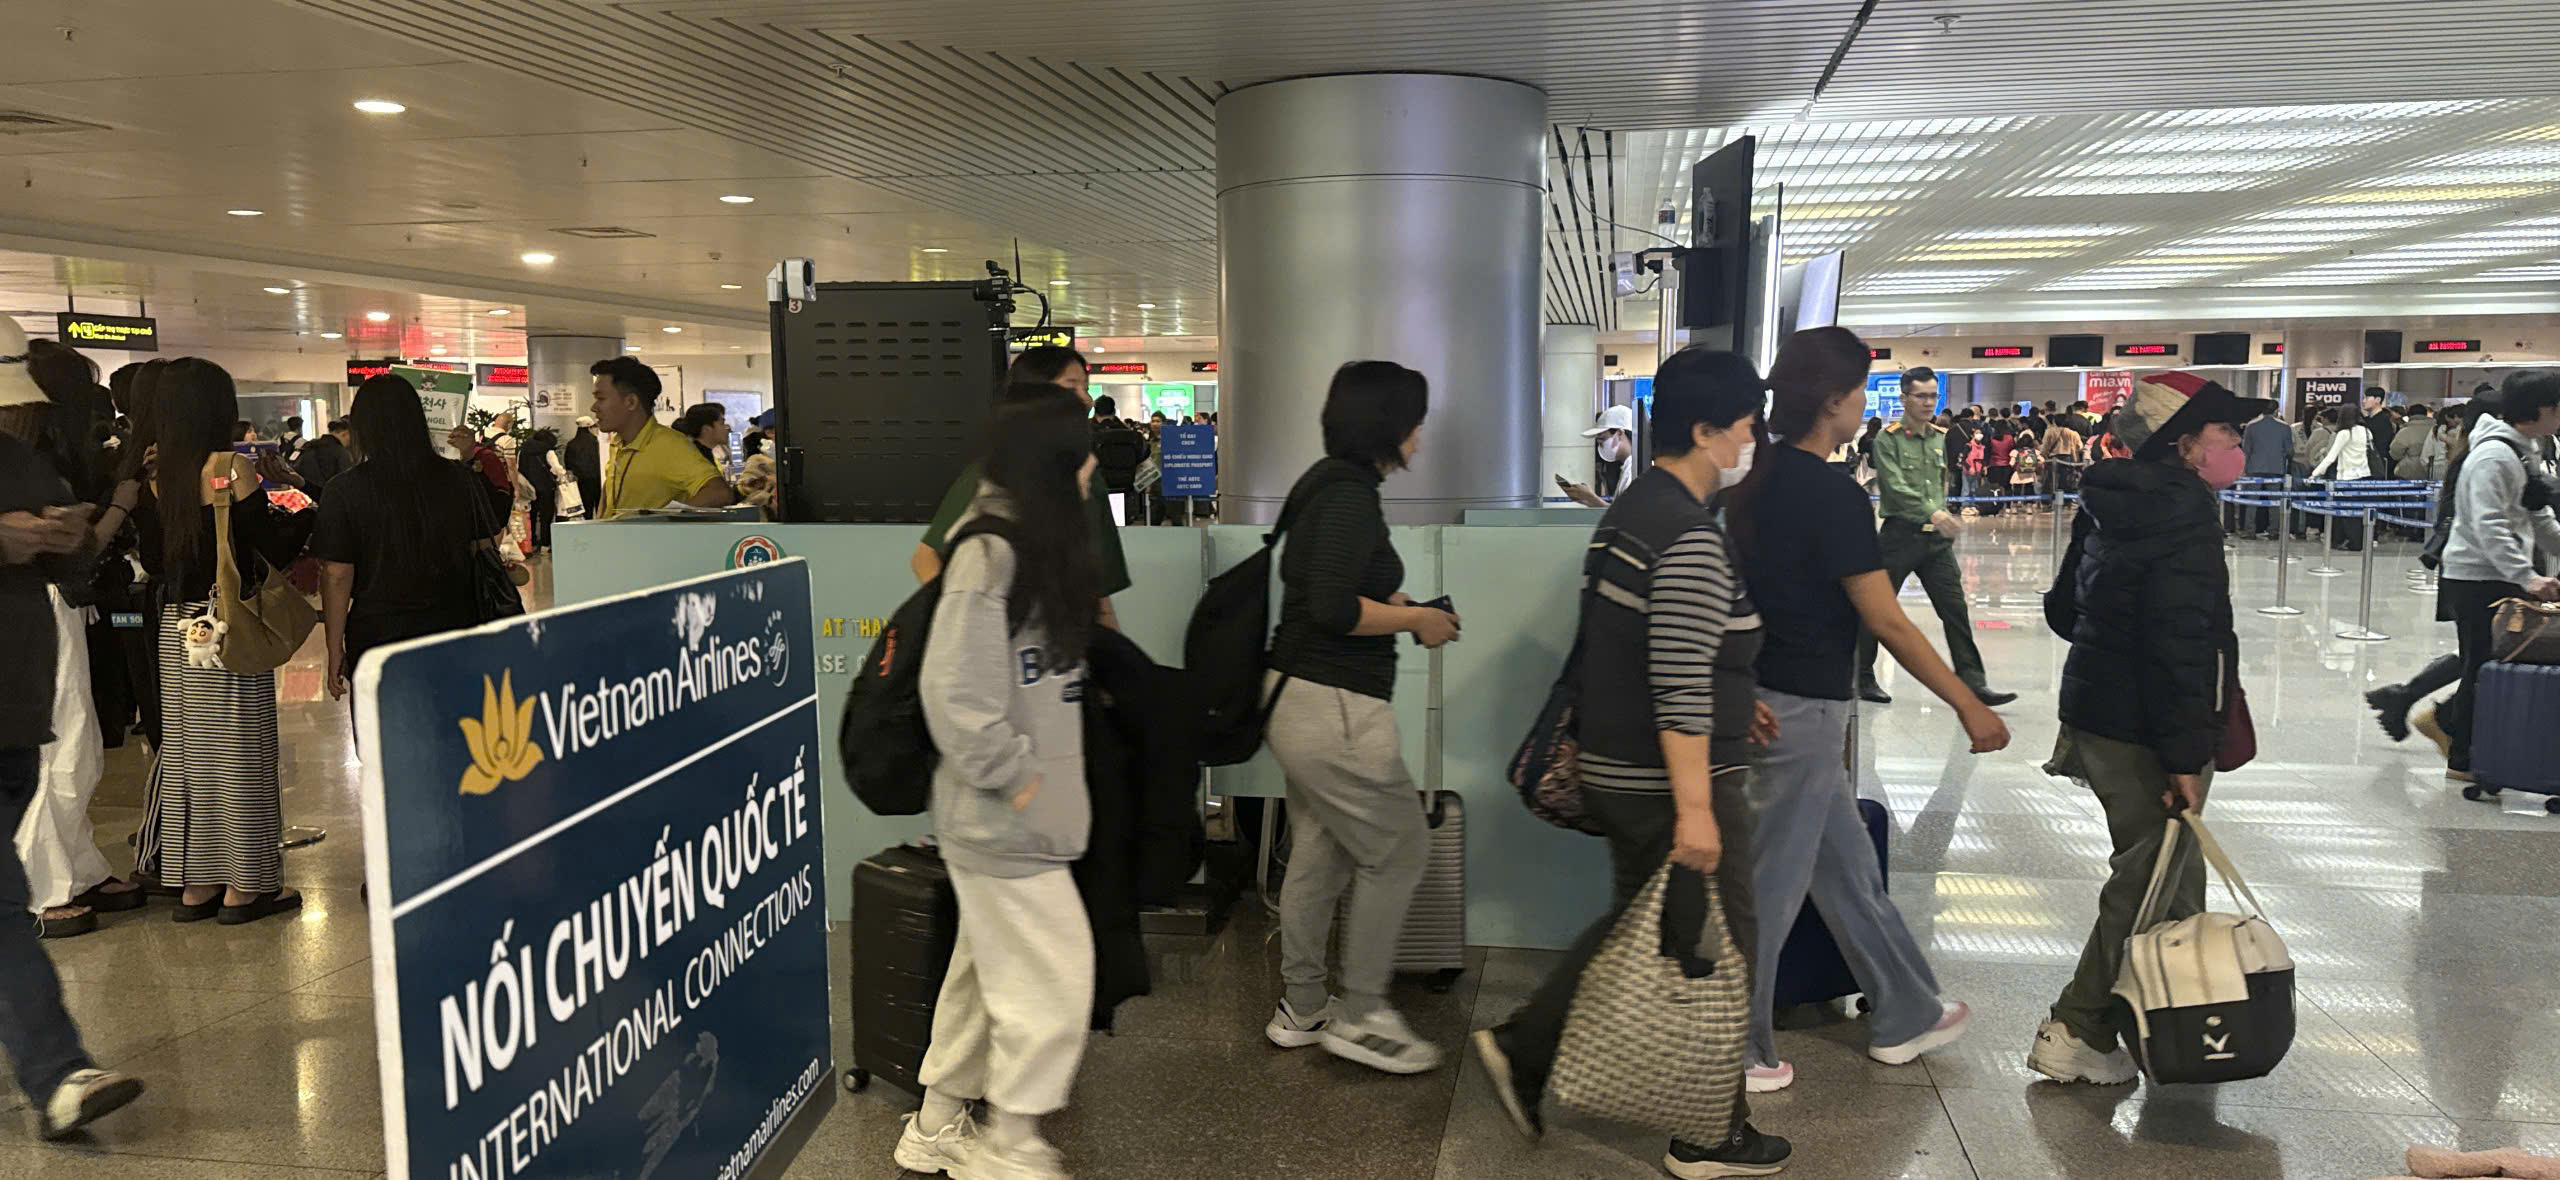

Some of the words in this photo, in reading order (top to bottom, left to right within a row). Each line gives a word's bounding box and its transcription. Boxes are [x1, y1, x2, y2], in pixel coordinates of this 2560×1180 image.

[790, 300, 799, 311] 3
[2089, 377, 2131, 388] mia.vn
[2305, 381, 2347, 392] Hawa
[2305, 392, 2342, 404] Expo
[824, 618, 843, 637] AT
[539, 667, 675, 760] Vietnam
[675, 636, 762, 709] Airlines
[440, 919, 537, 1110] NỐI
[545, 824, 696, 1023] CHUYẾN
[700, 771, 780, 909] QUỐC
[778, 744, 808, 847] TẾ
[684, 863, 812, 1011] CONNECTIONS
[717, 1058, 819, 1180] ietnamairlines.com
